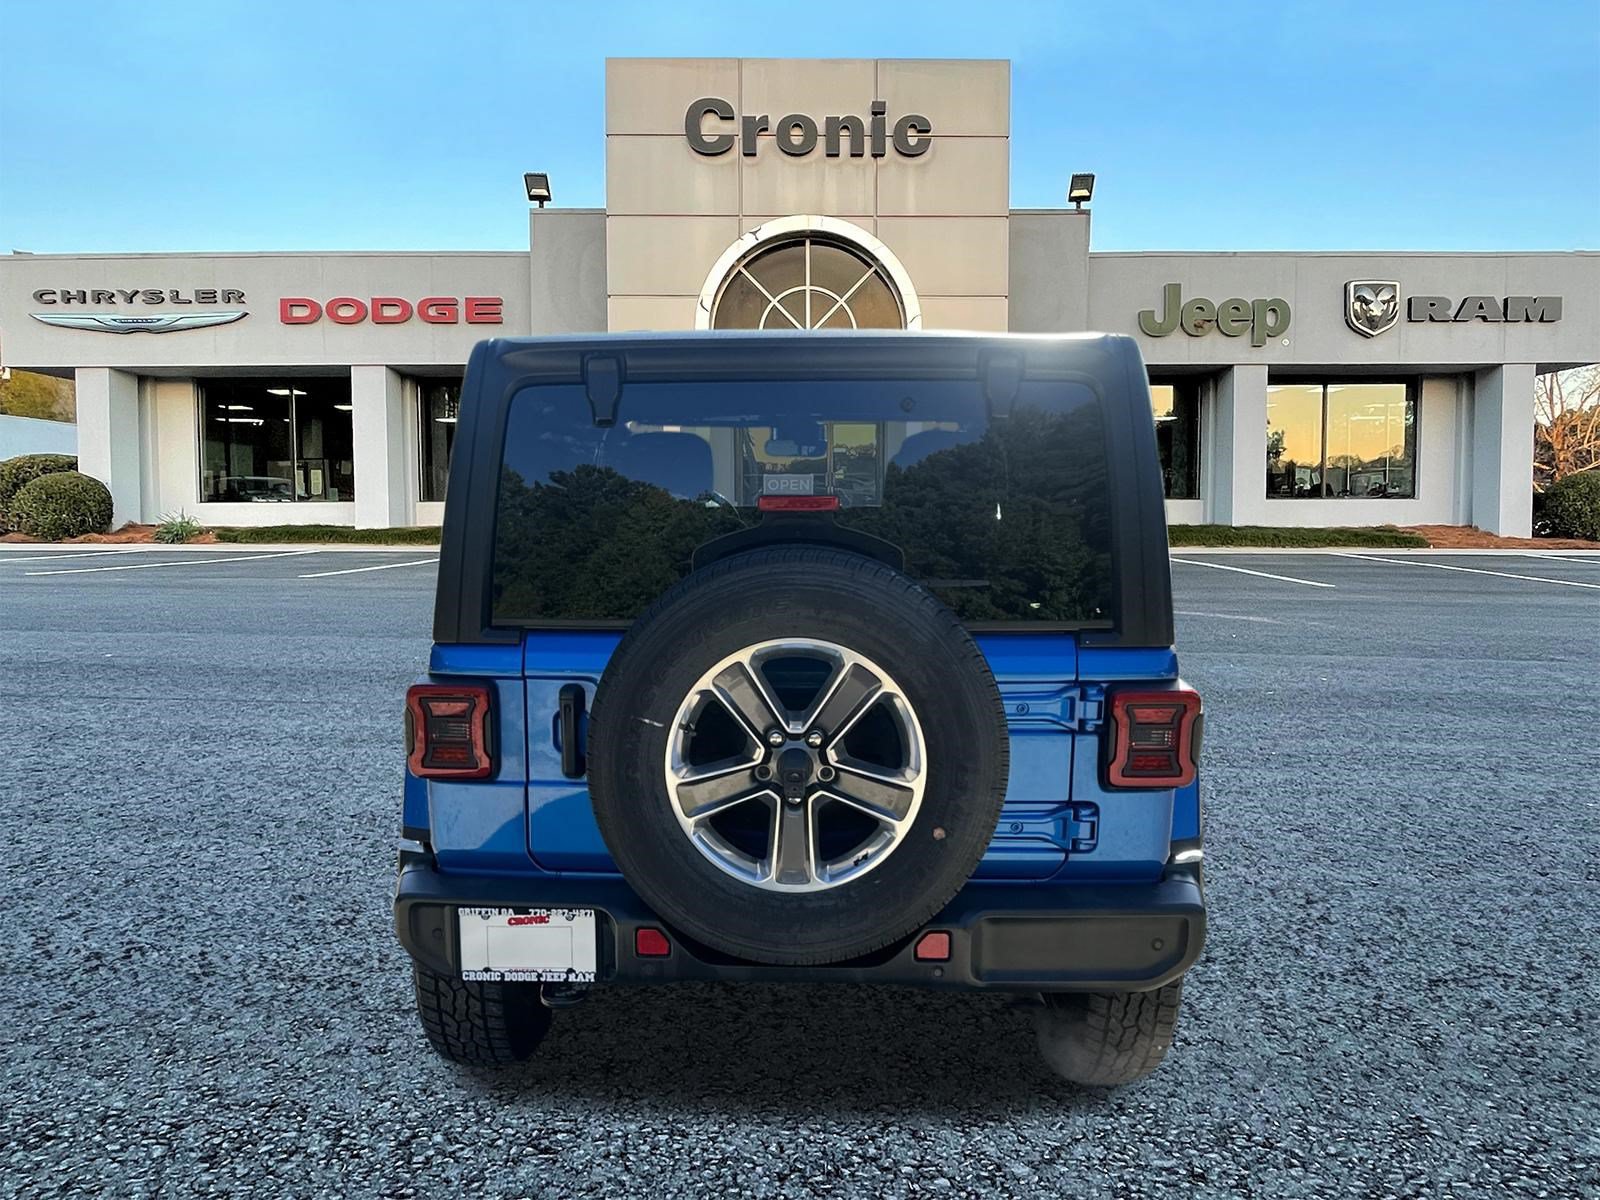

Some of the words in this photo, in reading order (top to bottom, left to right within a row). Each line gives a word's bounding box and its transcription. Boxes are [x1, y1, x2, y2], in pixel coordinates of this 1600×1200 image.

[685, 97, 932, 158] Cronic
[32, 288, 247, 305] CHRYSLER
[280, 296, 504, 325] DODGE
[1407, 295, 1563, 323] RAM
[1138, 283, 1291, 347] Jeep
[767, 479, 810, 491] OPEN
[462, 971, 502, 982] CRONIC
[504, 971, 537, 982] DODGE
[540, 972, 566, 983] JEEP
[568, 972, 595, 983] RAM
